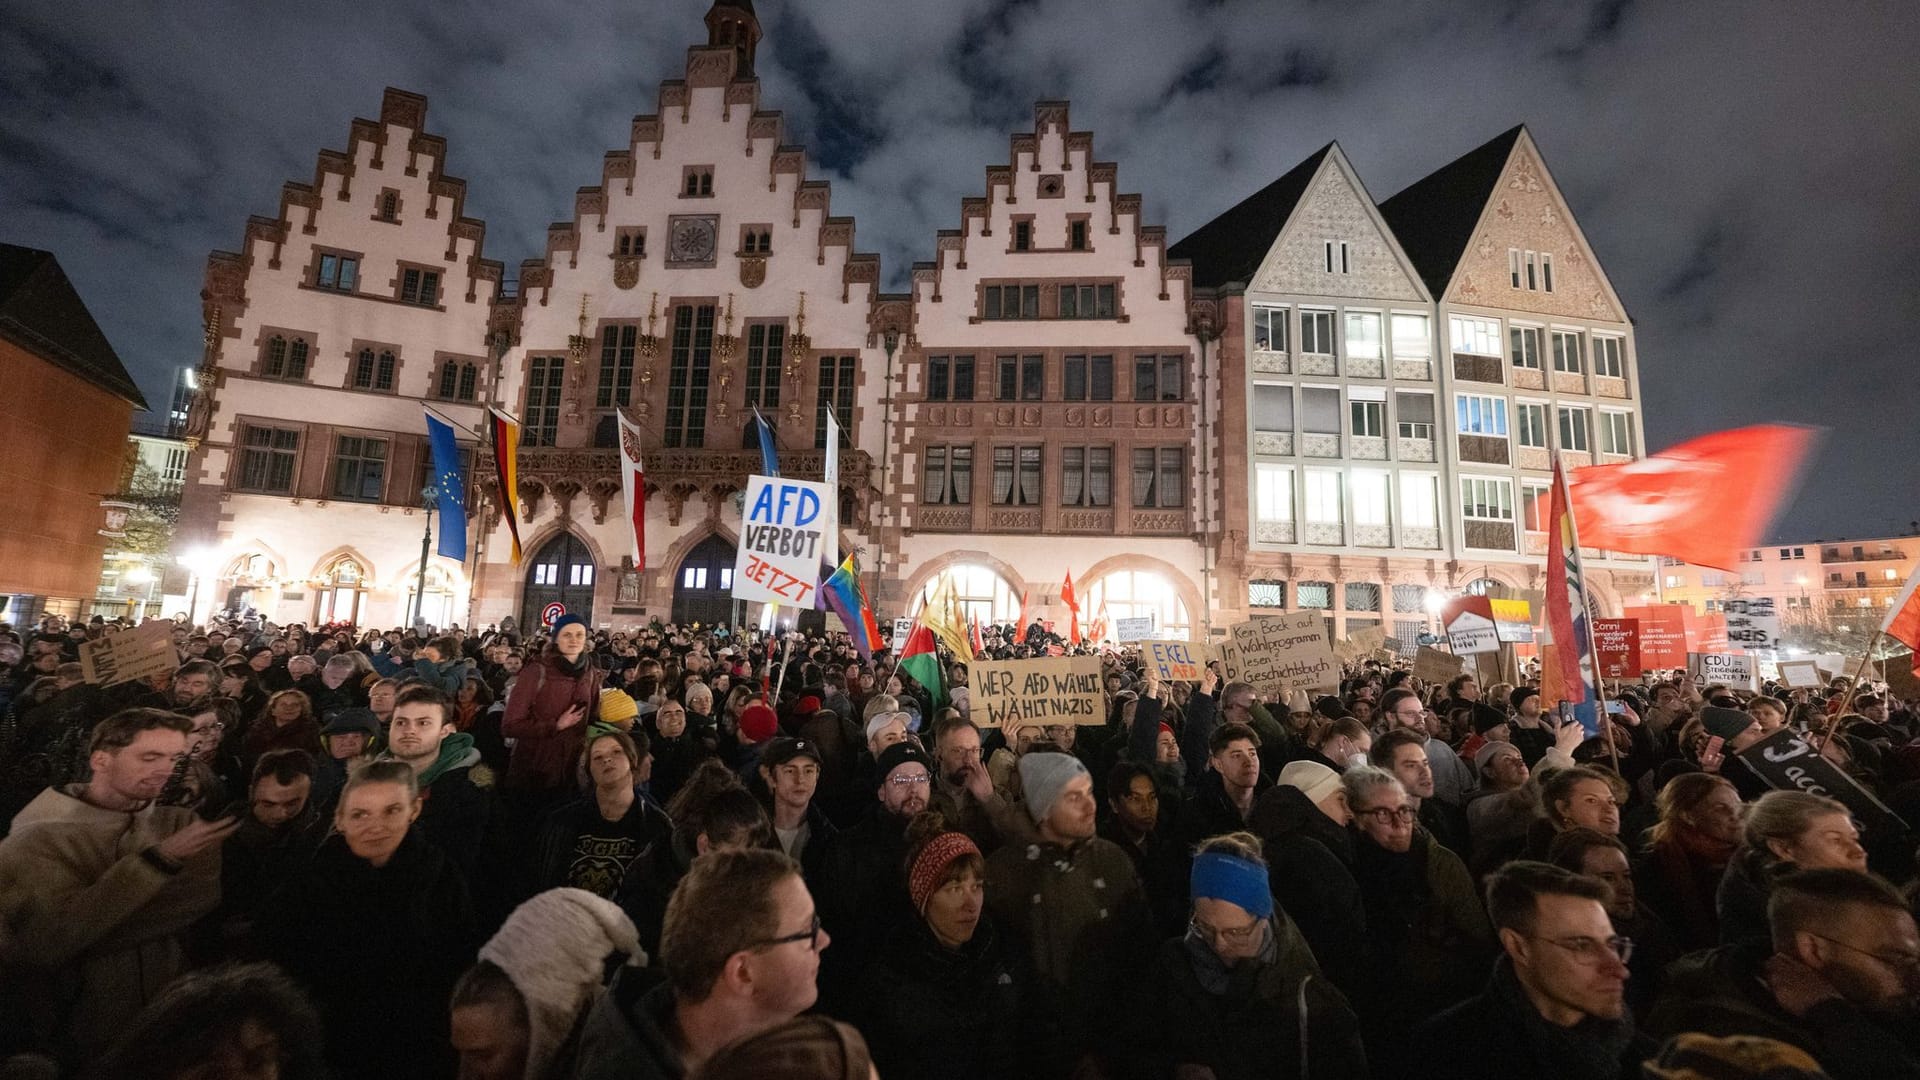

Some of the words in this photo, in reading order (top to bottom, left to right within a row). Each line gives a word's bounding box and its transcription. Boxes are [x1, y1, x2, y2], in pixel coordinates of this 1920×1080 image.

[750, 484, 820, 526] AFD
[745, 524, 821, 559] VERBOT
[745, 554, 814, 601] JETZT
[1233, 626, 1256, 640] Kein
[1260, 618, 1288, 635] Bock
[1296, 614, 1313, 628] auf
[1592, 620, 1620, 631] Conni
[1152, 643, 1196, 664] EKEL
[1237, 633, 1321, 654] Wahlprogramm
[1602, 643, 1630, 652] rechts
[1243, 657, 1330, 684] Geschichtsbuch
[1704, 655, 1731, 667] CDU
[977, 670, 1016, 698] WER
[1023, 672, 1049, 696] AFD
[987, 697, 1048, 724] WÄHLT
[1051, 698, 1093, 717] NAZIS
